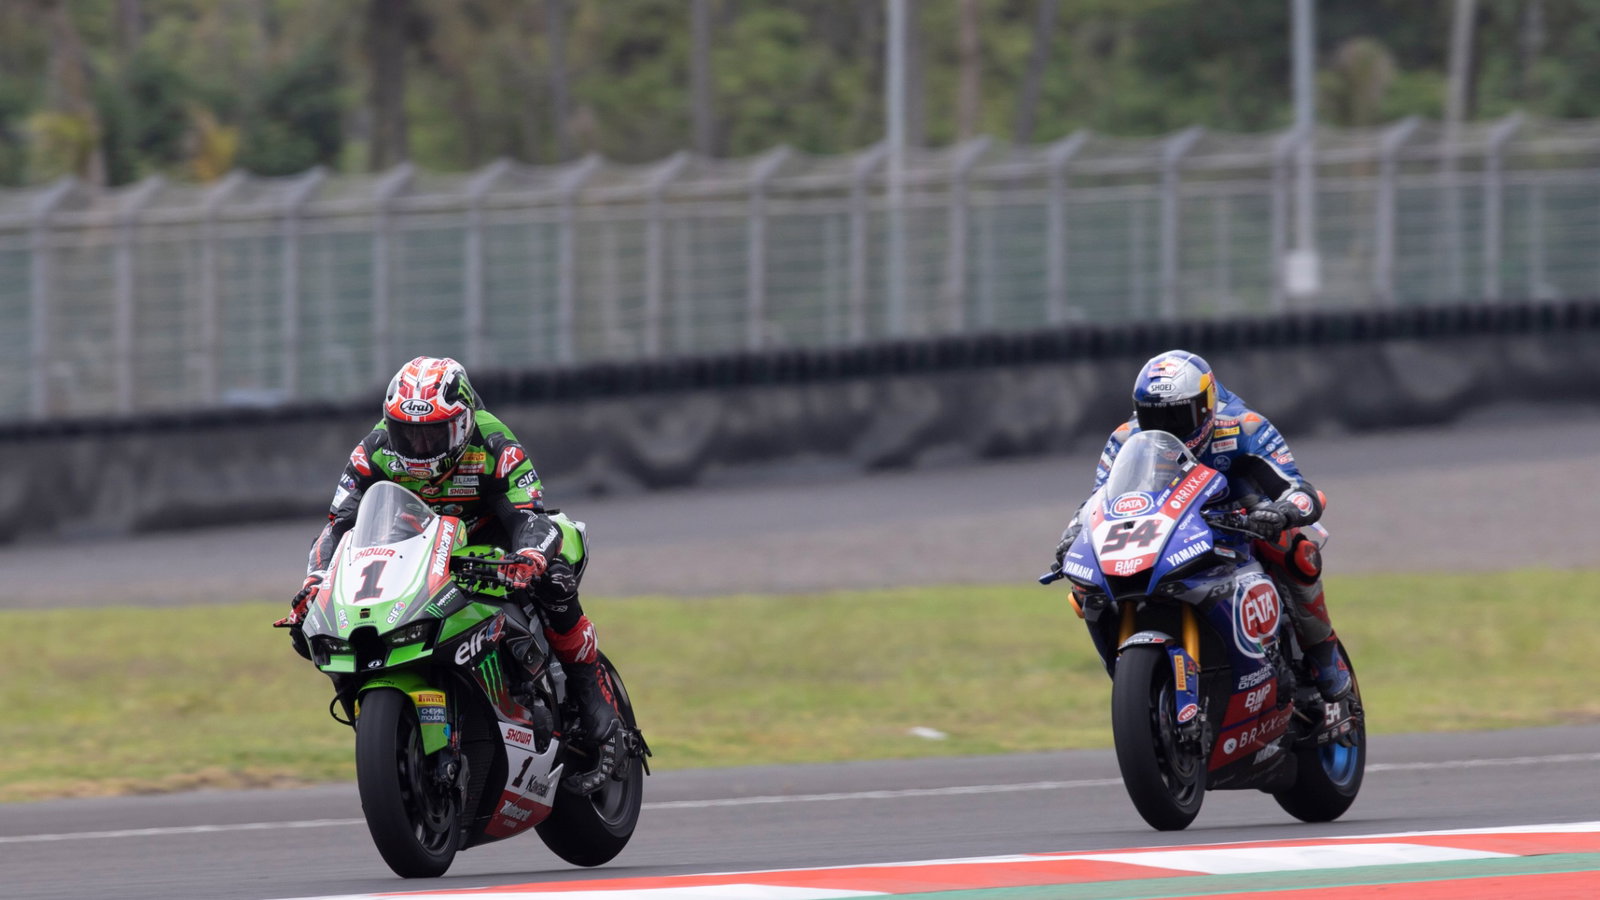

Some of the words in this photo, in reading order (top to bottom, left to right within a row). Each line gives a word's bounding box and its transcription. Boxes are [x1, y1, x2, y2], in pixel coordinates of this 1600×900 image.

[405, 401, 429, 411] Arai
[1118, 499, 1143, 510] PATA
[1100, 519, 1163, 556] 54
[354, 547, 396, 561] SHOWA
[1166, 540, 1211, 567] YAMAHA
[1064, 561, 1094, 580] YAMAHA
[1114, 559, 1143, 573] BMP
[353, 560, 387, 604] 1
[1245, 591, 1277, 631] PATA
[1244, 684, 1271, 708] BMP
[1325, 702, 1342, 726] 54
[505, 728, 533, 746] SHOWA
[511, 755, 534, 788] 1
